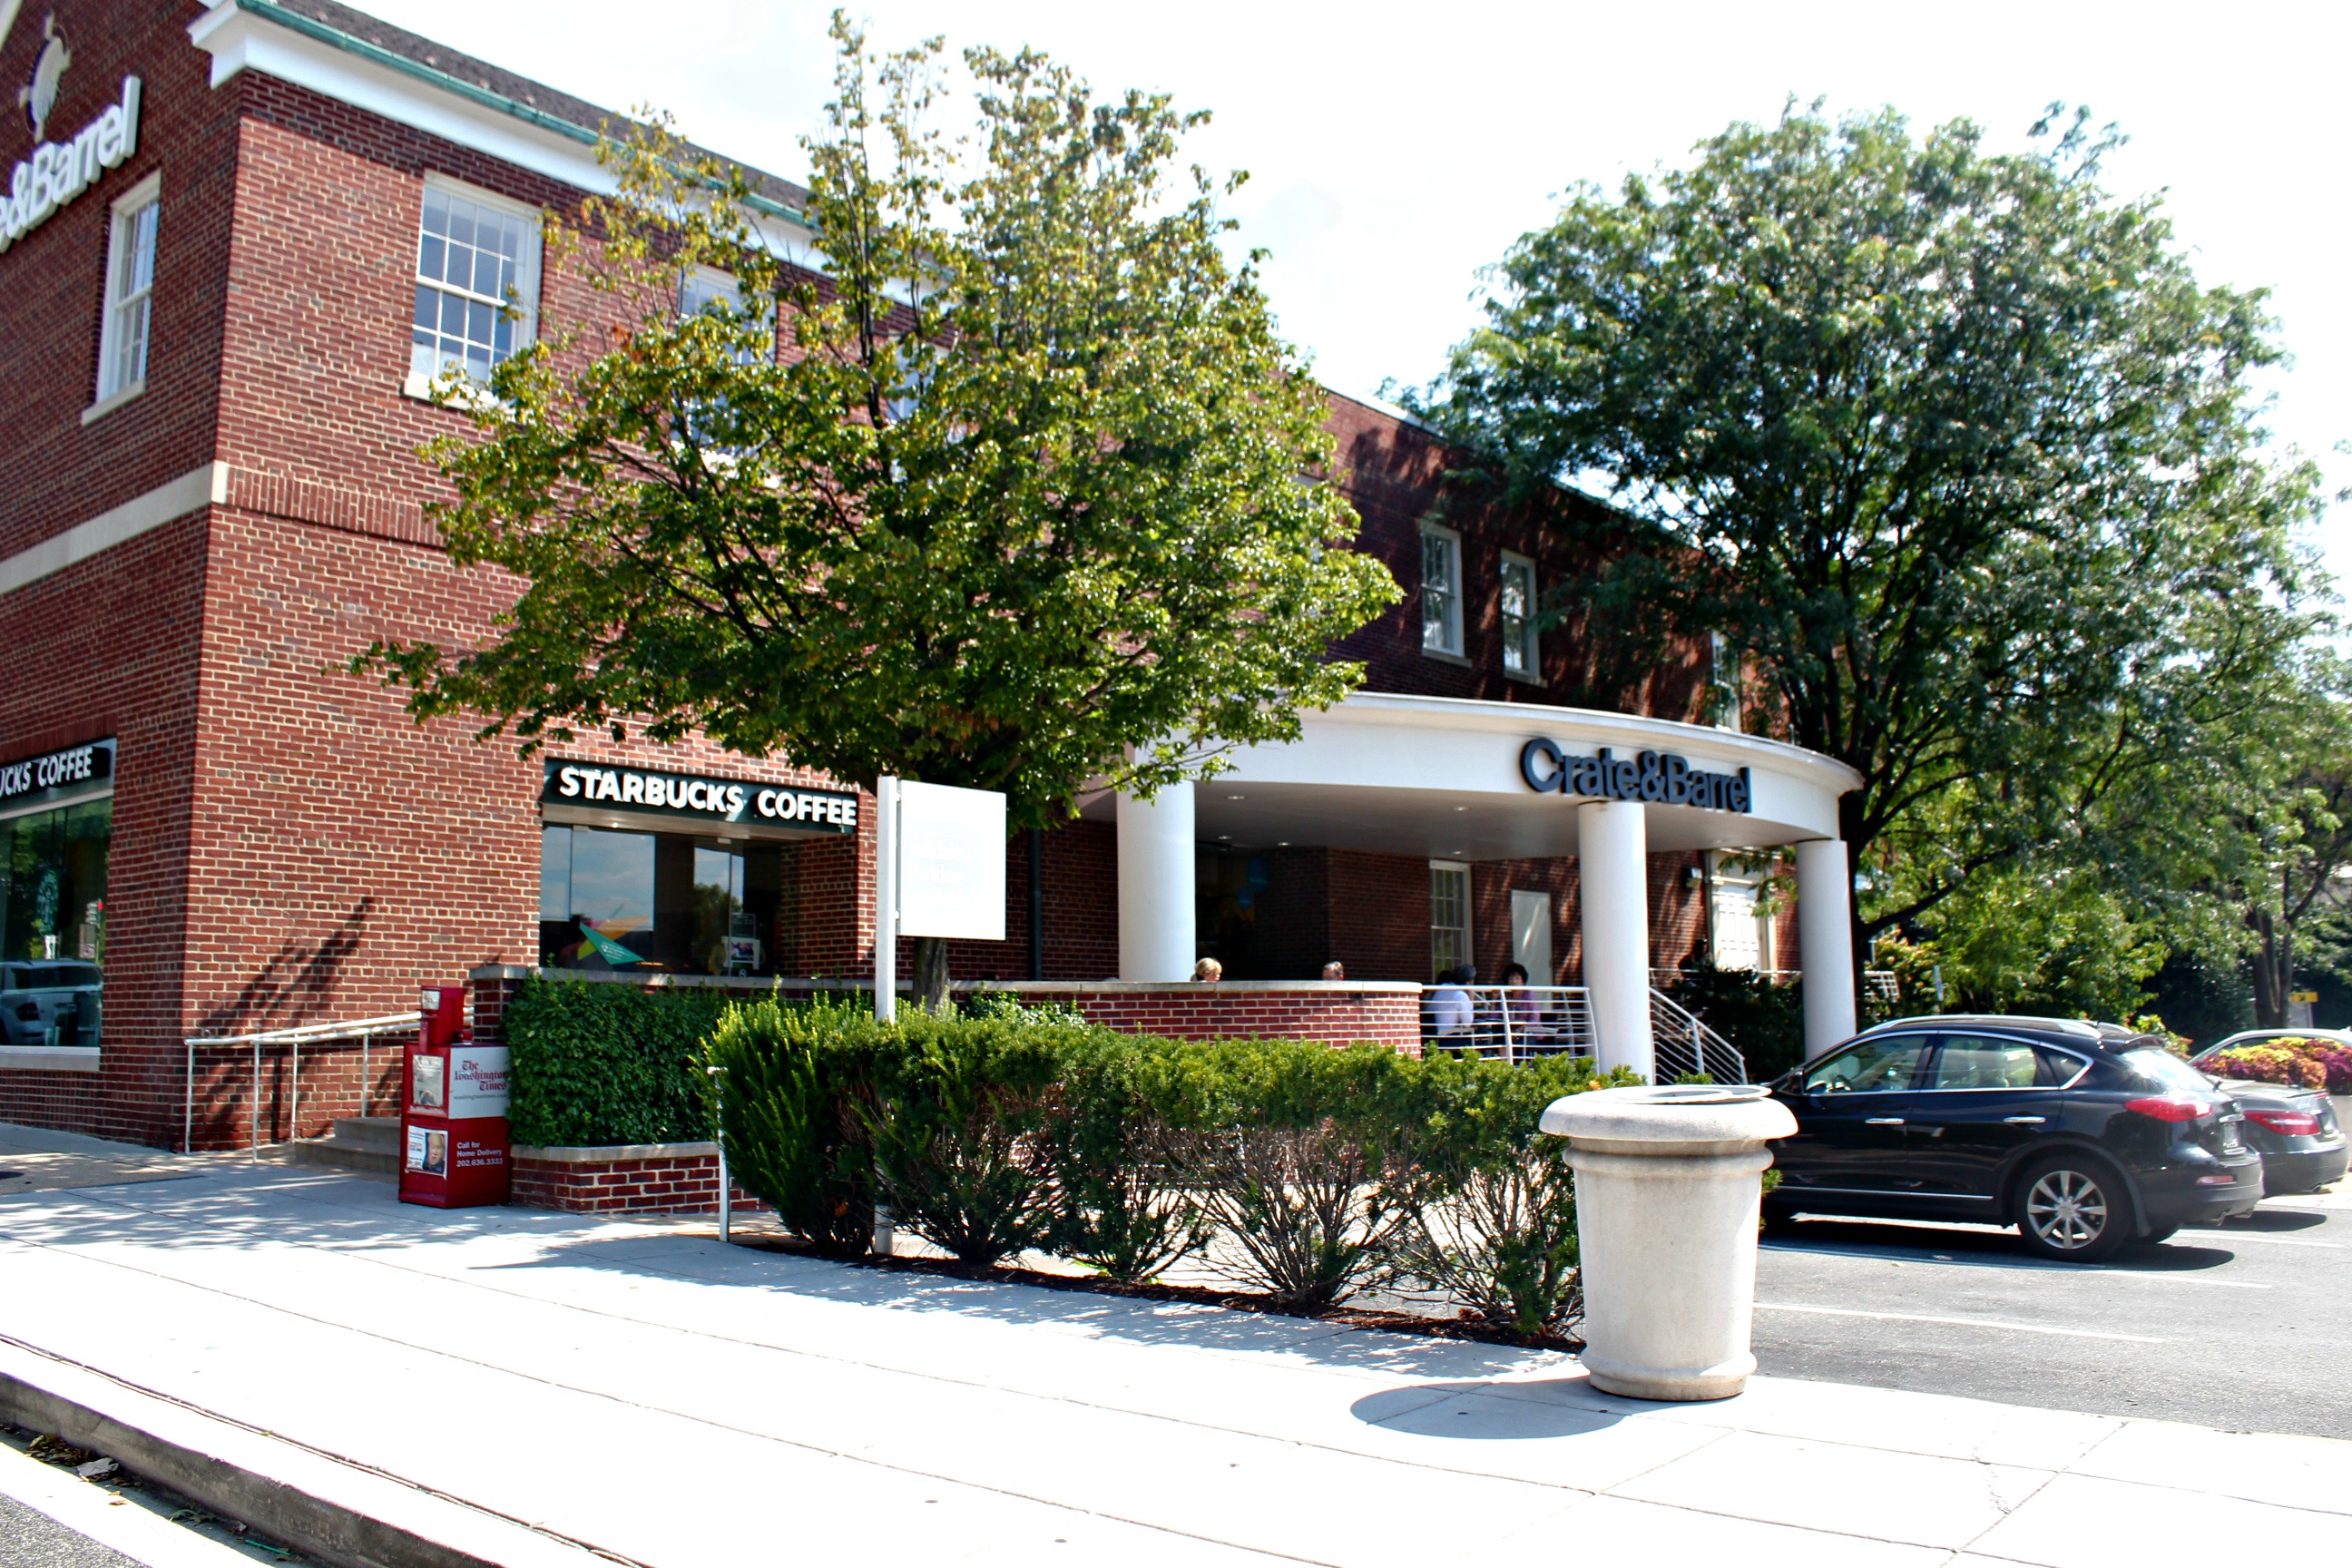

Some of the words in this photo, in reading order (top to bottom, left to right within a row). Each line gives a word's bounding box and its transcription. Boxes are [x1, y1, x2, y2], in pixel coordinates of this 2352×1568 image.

[37, 746, 93, 788] COFFEE
[1520, 737, 1752, 813] Crate&Barrel
[559, 766, 744, 813] STARBUCKS
[757, 789, 858, 827] COFFEE
[462, 1060, 478, 1070] The
[456, 1142, 470, 1150] Call
